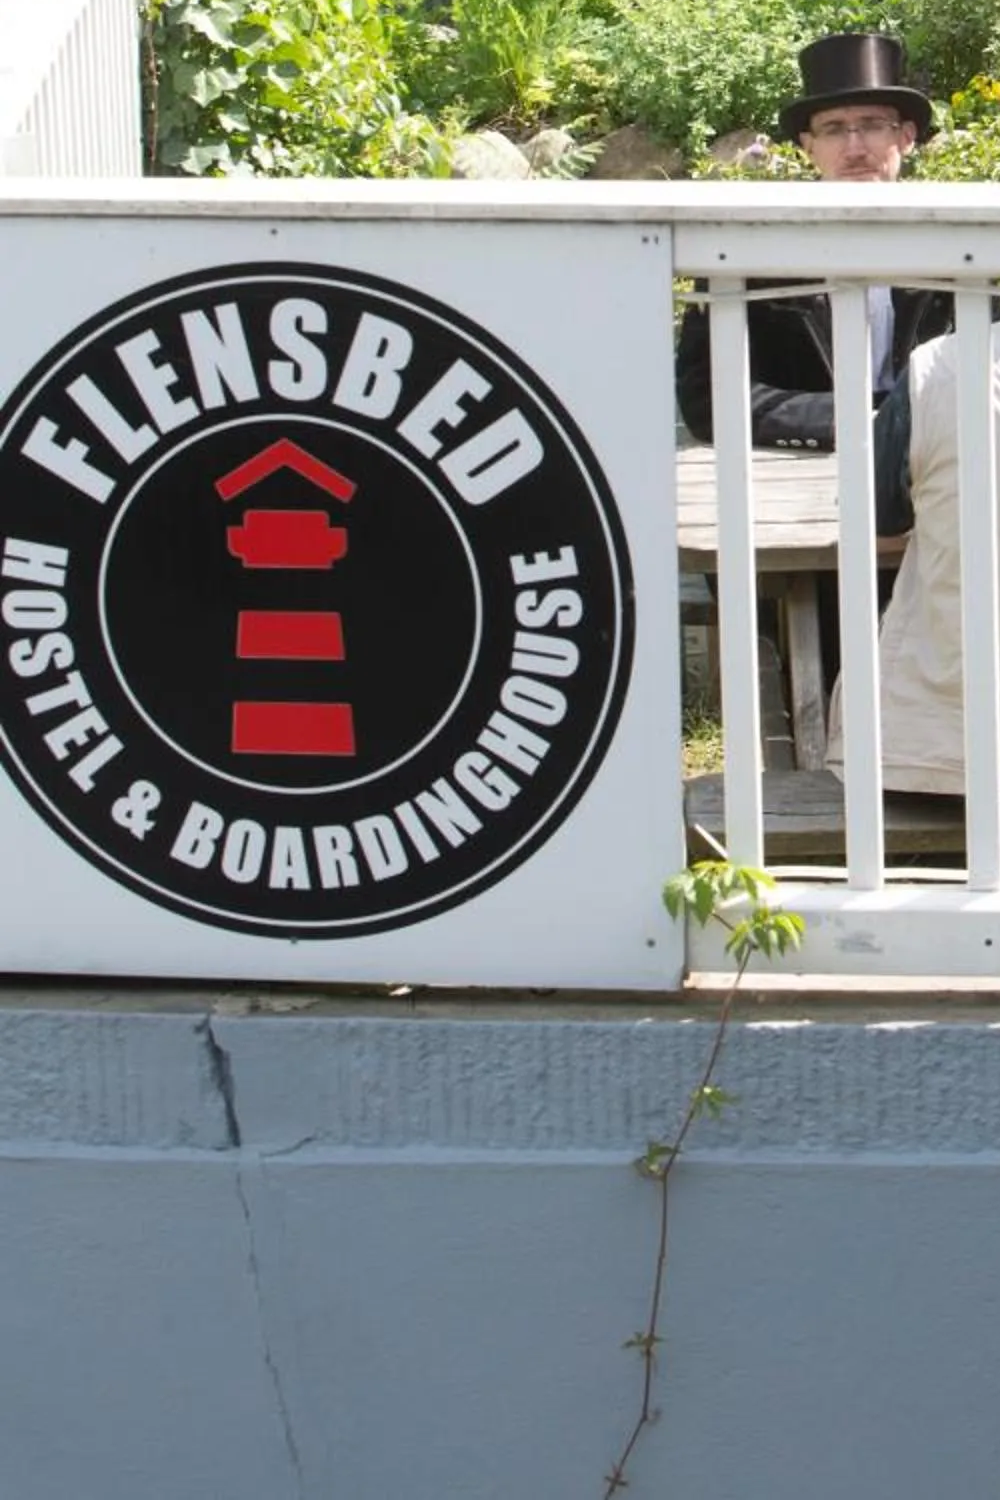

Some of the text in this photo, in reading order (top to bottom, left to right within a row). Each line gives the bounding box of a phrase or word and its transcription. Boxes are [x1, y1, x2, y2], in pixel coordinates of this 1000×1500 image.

[20, 298, 545, 506] FLENSBED
[0, 537, 584, 891] HOSTEL & BOARDINGHOUSE
